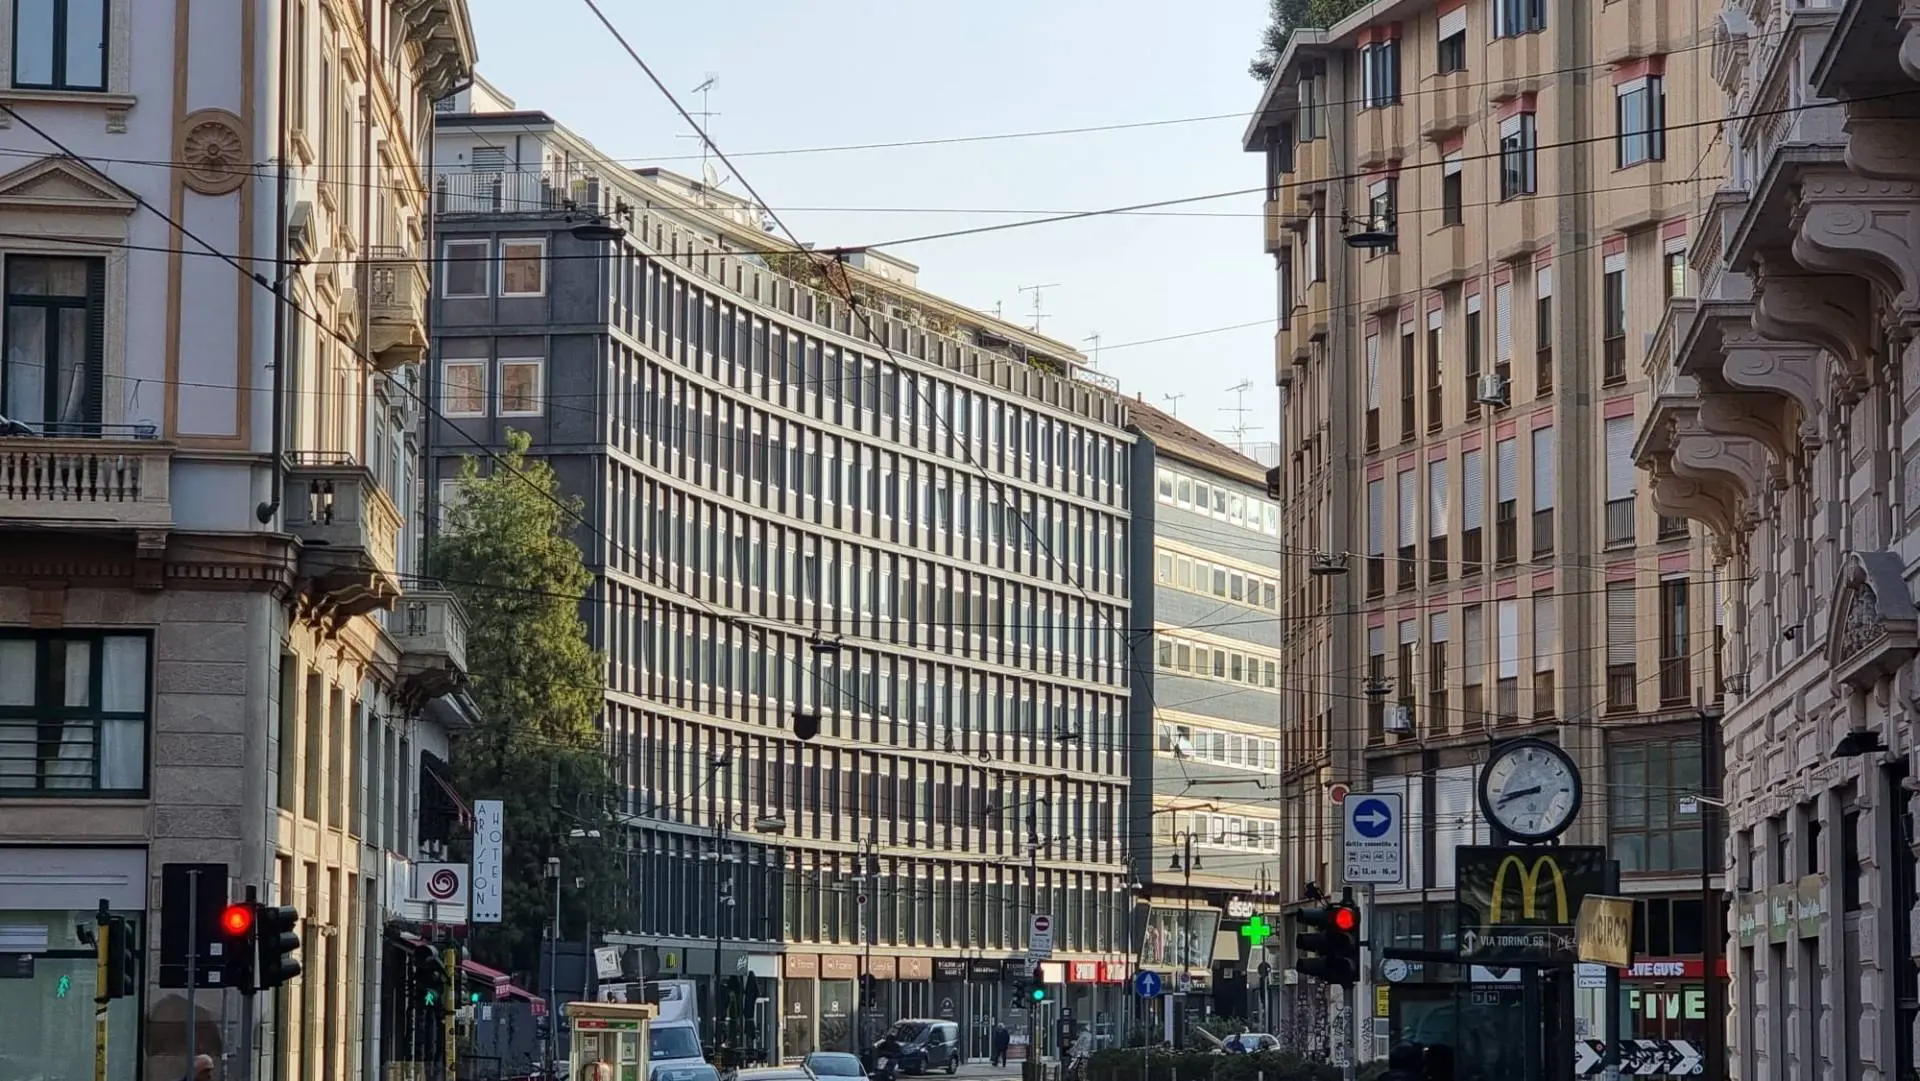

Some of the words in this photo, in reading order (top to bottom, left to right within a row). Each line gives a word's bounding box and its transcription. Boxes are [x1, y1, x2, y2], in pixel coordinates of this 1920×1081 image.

[474, 803, 488, 906] ARISTON
[489, 812, 502, 898] HOTEL
[1480, 935, 1495, 946] VIA
[1653, 962, 1684, 976] GUYS
[1629, 990, 1705, 1019] FIVE
